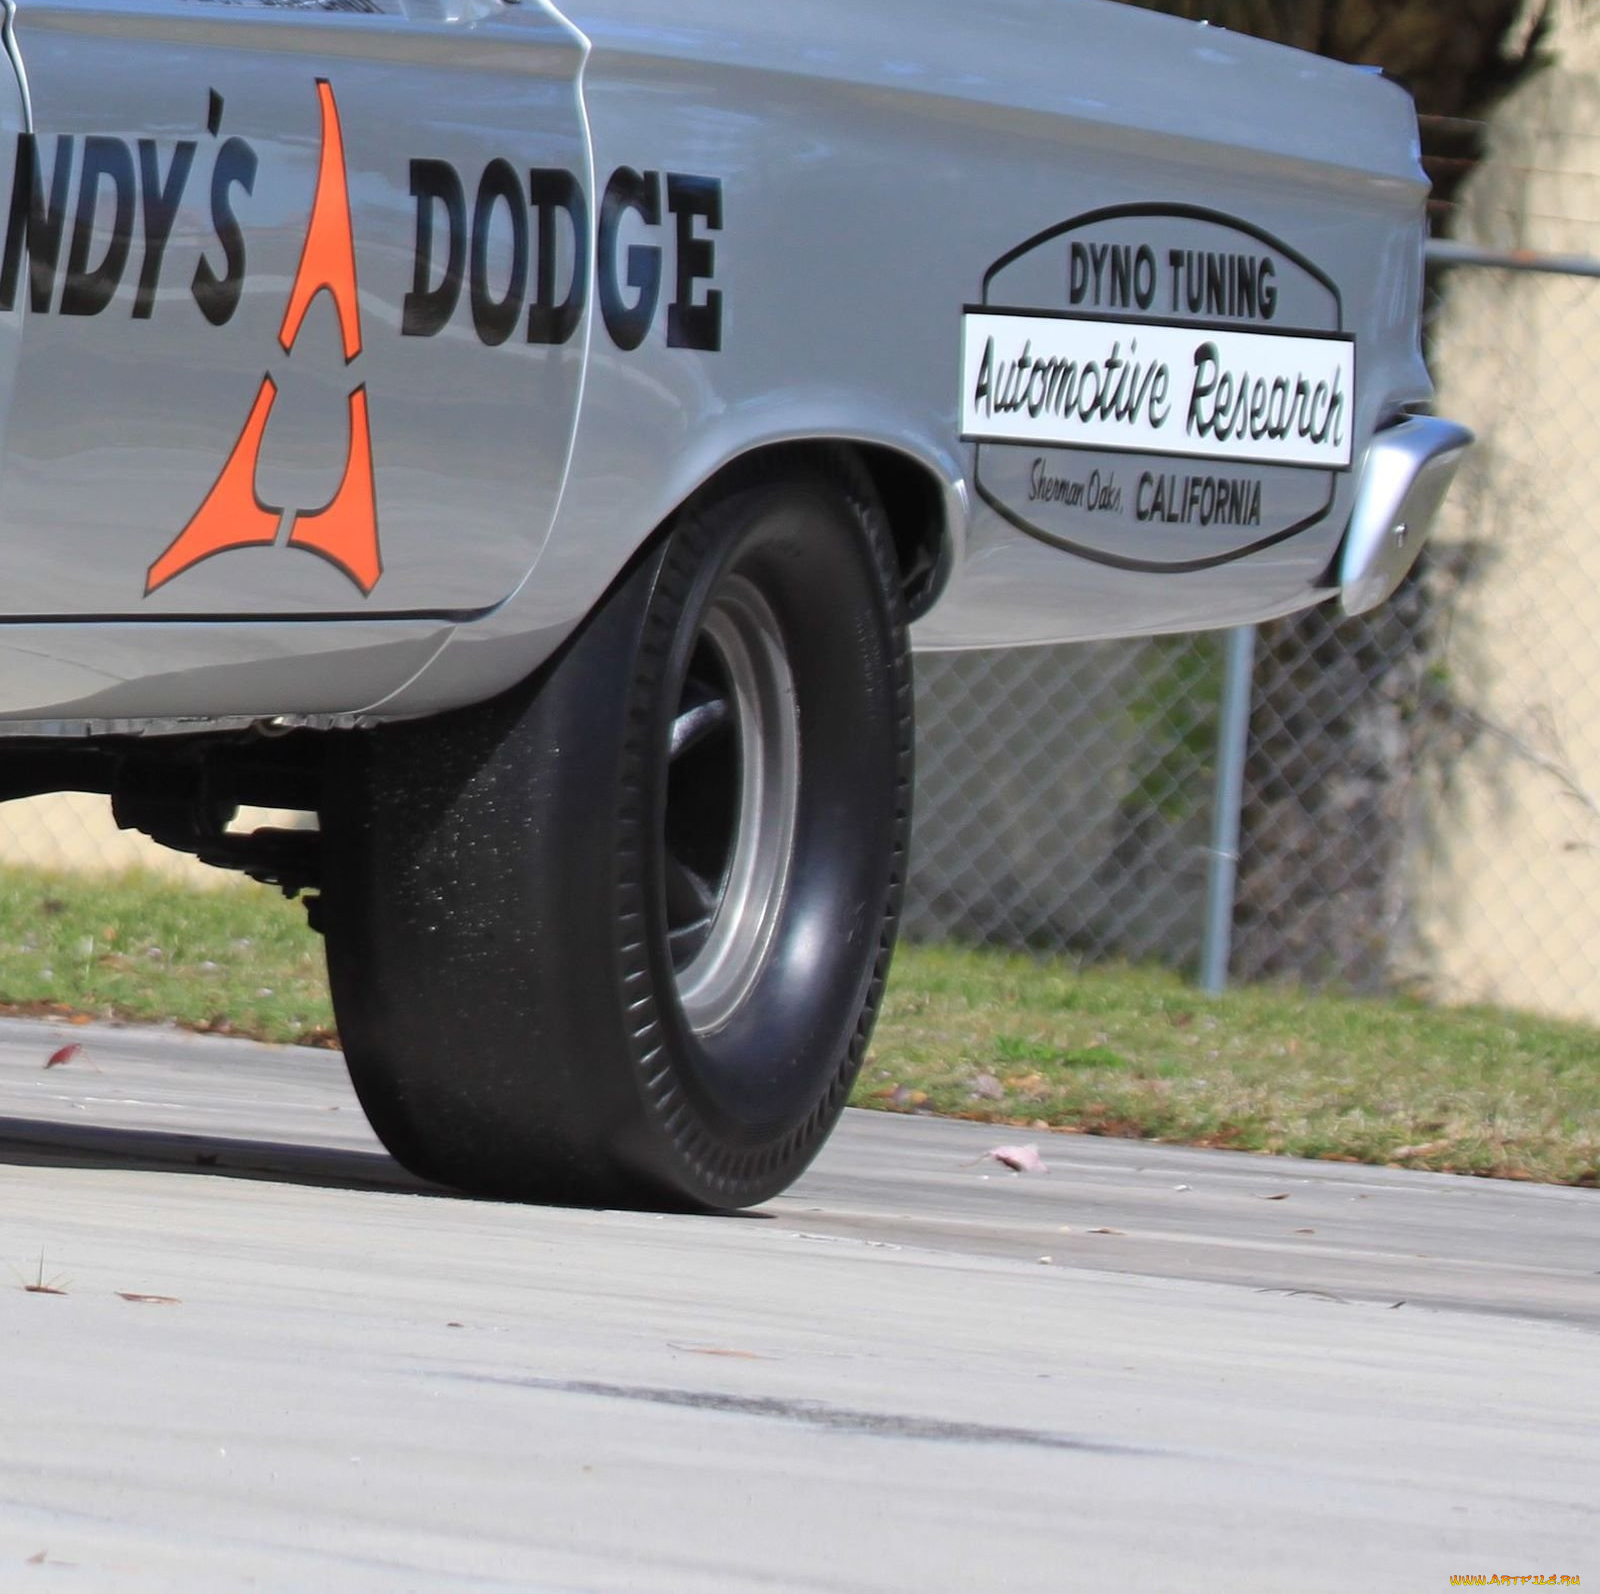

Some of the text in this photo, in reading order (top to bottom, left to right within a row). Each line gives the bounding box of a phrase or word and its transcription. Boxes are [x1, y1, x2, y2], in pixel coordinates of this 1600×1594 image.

[402, 157, 723, 351] DODGE
[1069, 242, 1278, 320] DYNO TUNING
[974, 334, 1345, 448] Automotive Research
[1028, 456, 1085, 508] Sherman
[1136, 470, 1262, 526] CALIFORNIA
